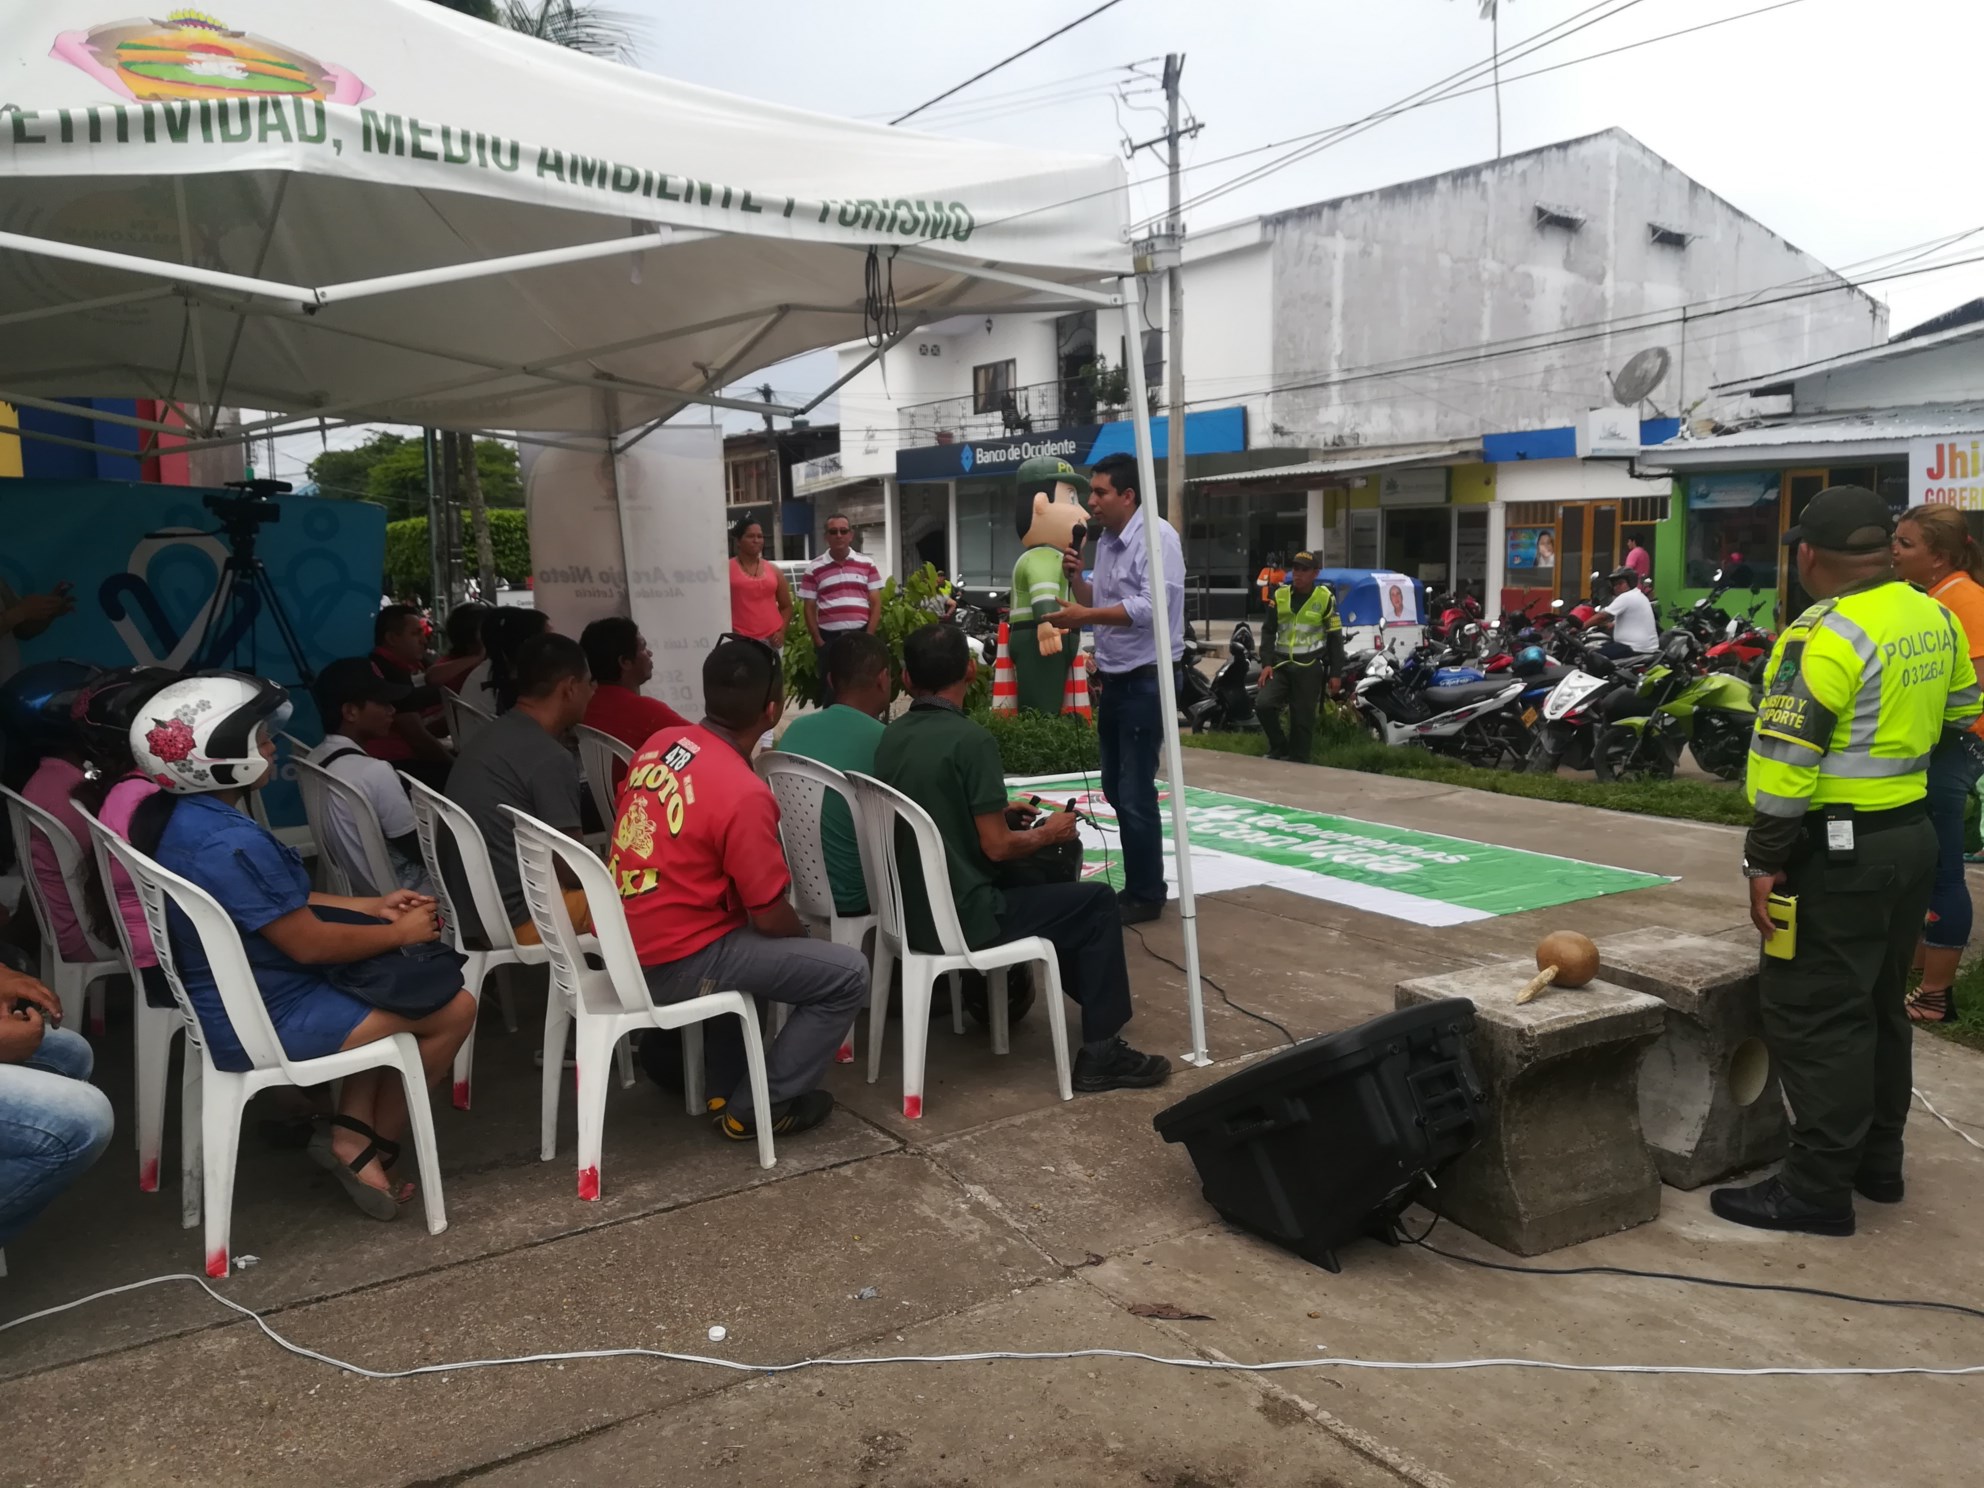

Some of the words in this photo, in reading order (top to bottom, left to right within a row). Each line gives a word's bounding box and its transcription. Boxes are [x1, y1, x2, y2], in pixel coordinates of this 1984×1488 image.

[976, 448, 1006, 464] Banco
[1007, 444, 1020, 460] de
[1021, 439, 1076, 459] Occidente
[1924, 487, 1984, 511] GOBER
[1882, 629, 1952, 666] POLICIA
[1797, 698, 1807, 713] Y
[665, 745, 692, 771] 478
[626, 763, 685, 837] MOTO
